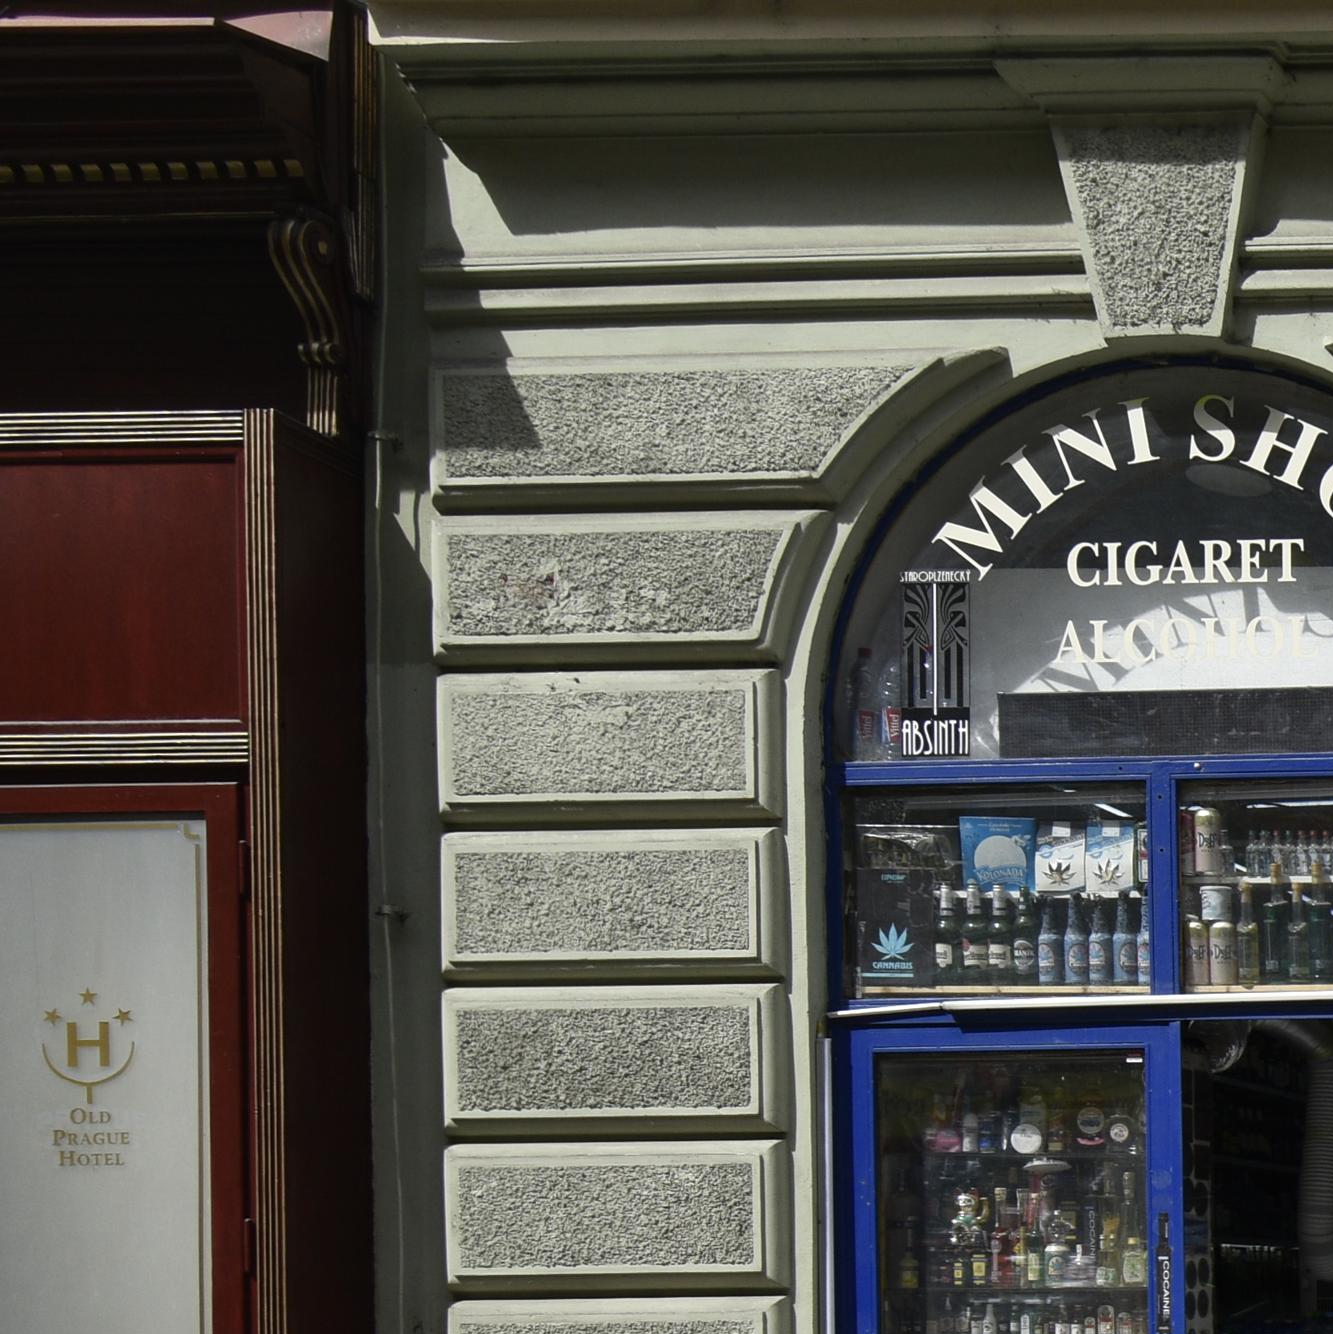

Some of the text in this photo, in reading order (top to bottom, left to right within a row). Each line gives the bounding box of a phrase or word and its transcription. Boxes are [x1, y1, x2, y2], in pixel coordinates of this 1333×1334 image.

[931, 397, 1160, 581] MINI
[1067, 538, 1305, 587] CIGARET
[1054, 614, 1321, 664] ALCOHOL
[902, 720, 969, 756] ABSINTH
[69, 1107, 112, 1125] OLD
[52, 1129, 130, 1146] PRAGUE
[59, 1150, 125, 1167] HOTEL
[1163, 1260, 1171, 1315] COCAINE
